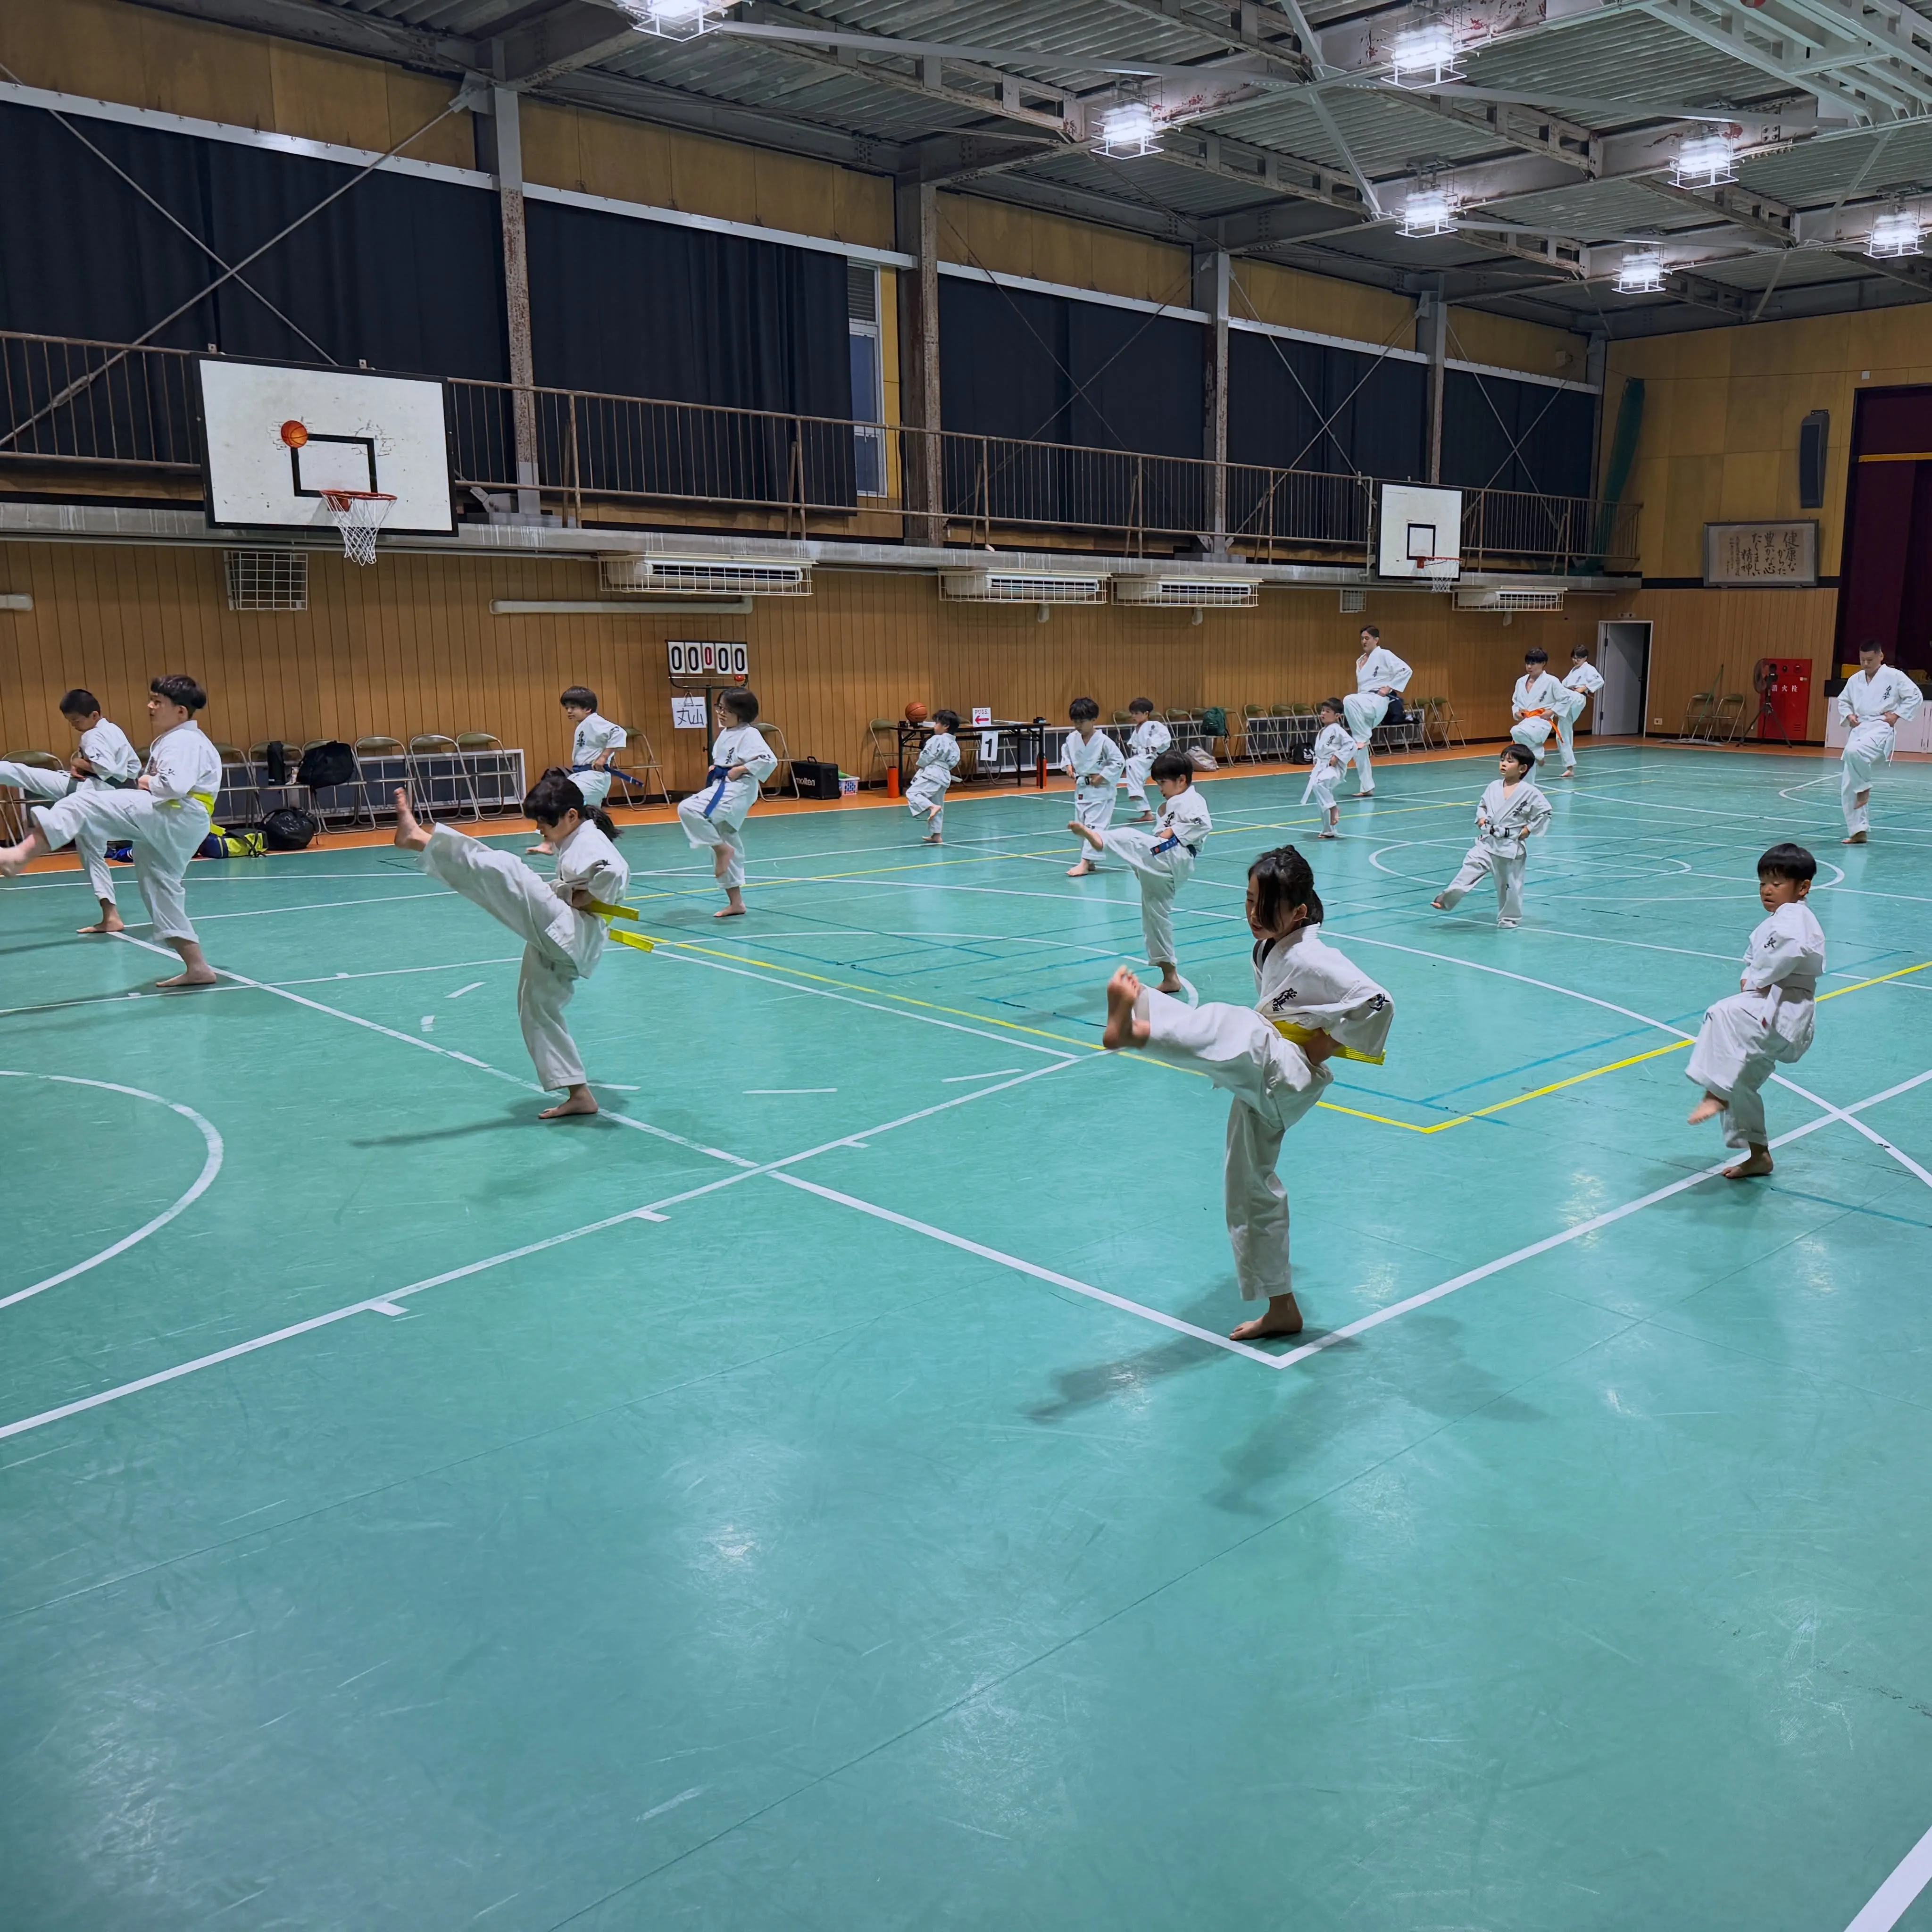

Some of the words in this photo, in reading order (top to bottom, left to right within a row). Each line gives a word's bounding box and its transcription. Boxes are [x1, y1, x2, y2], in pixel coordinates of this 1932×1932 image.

[1741, 548, 1753, 576] 精神
[1763, 531, 1775, 575] 豊かな心
[1783, 530, 1800, 572] 健康な
[676, 708, 704, 725] 丸山
[985, 738, 992, 757] 1
